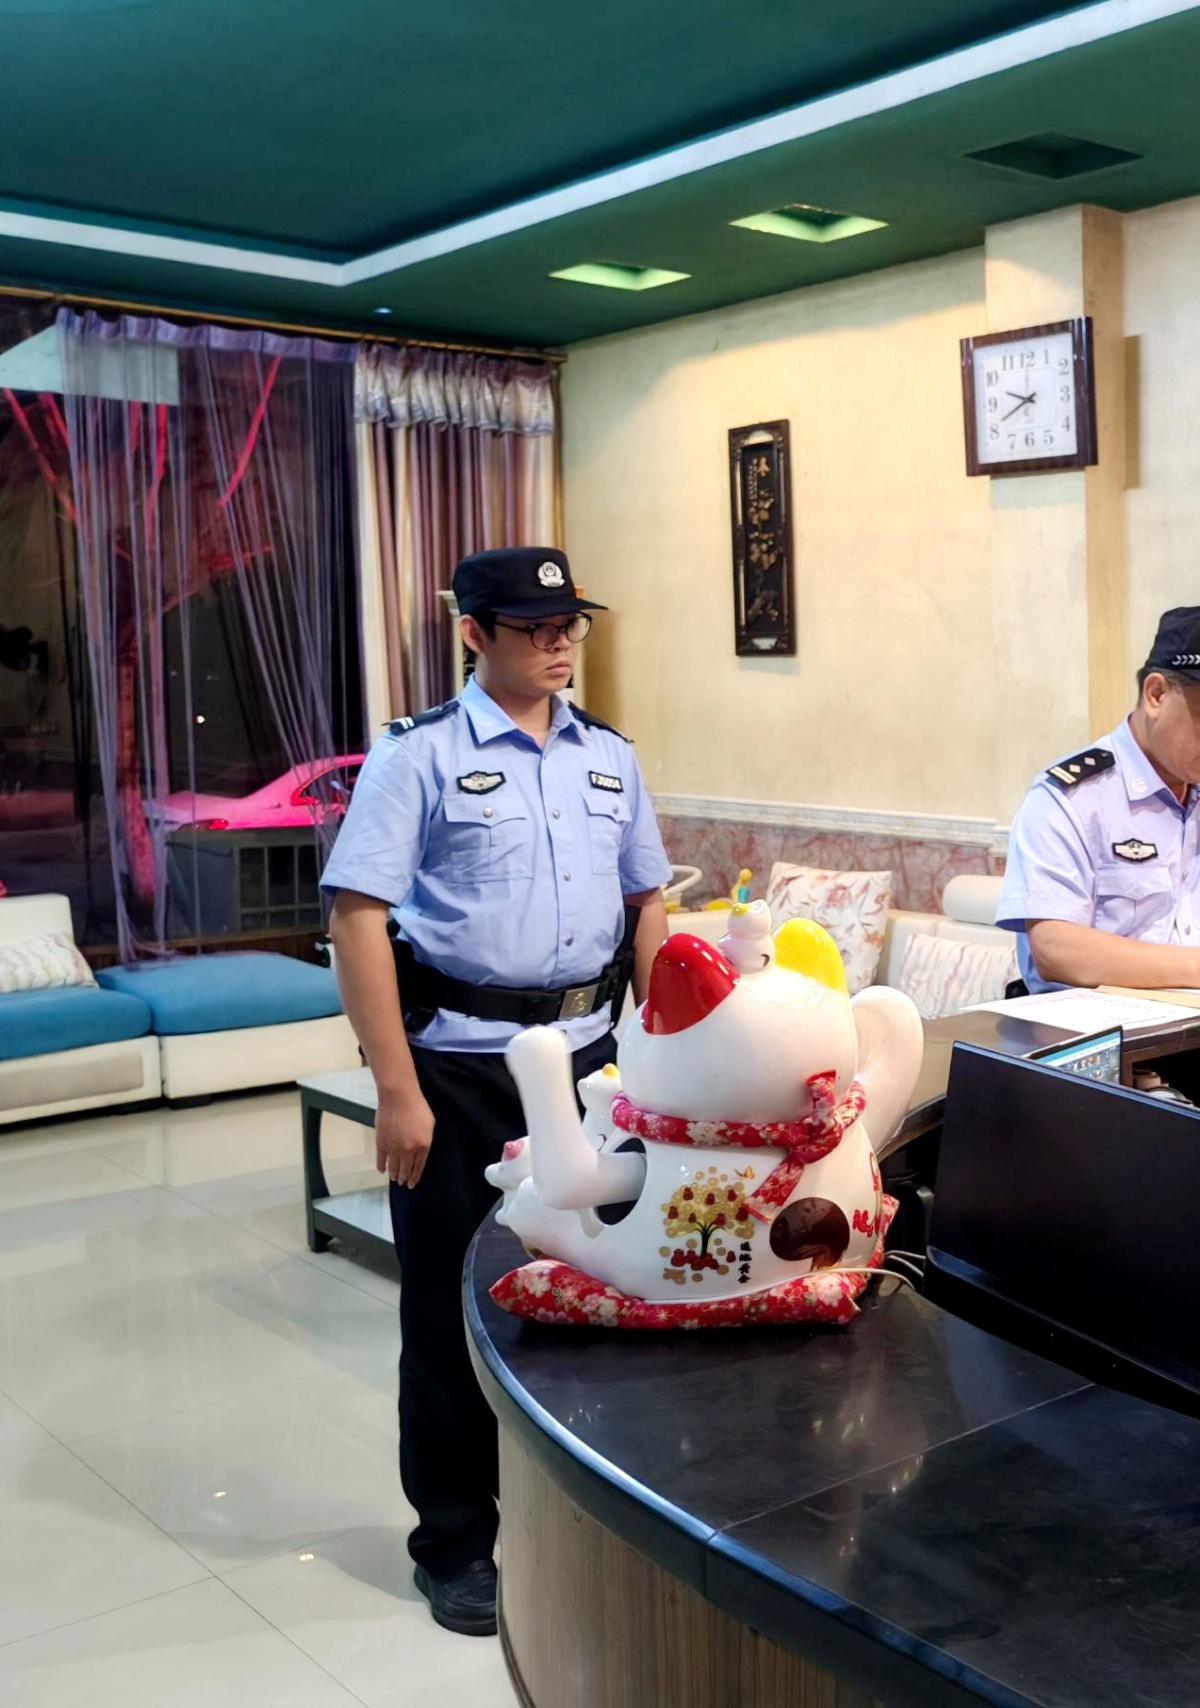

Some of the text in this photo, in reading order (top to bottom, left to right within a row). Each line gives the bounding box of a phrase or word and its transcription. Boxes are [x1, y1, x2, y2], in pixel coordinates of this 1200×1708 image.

[1002, 354, 1014, 371] 11
[1019, 351, 1036, 369] 12
[1043, 349, 1050, 365] 1
[1058, 358, 1070, 375] 2
[986, 370, 999, 387] 10
[1060, 386, 1070, 403] 3
[988, 397, 998, 413] 9
[989, 424, 1000, 440] 8
[1061, 416, 1070, 432] 4
[1007, 433, 1017, 450] 7
[1024, 431, 1035, 448] 6
[1043, 429, 1054, 446] 5
